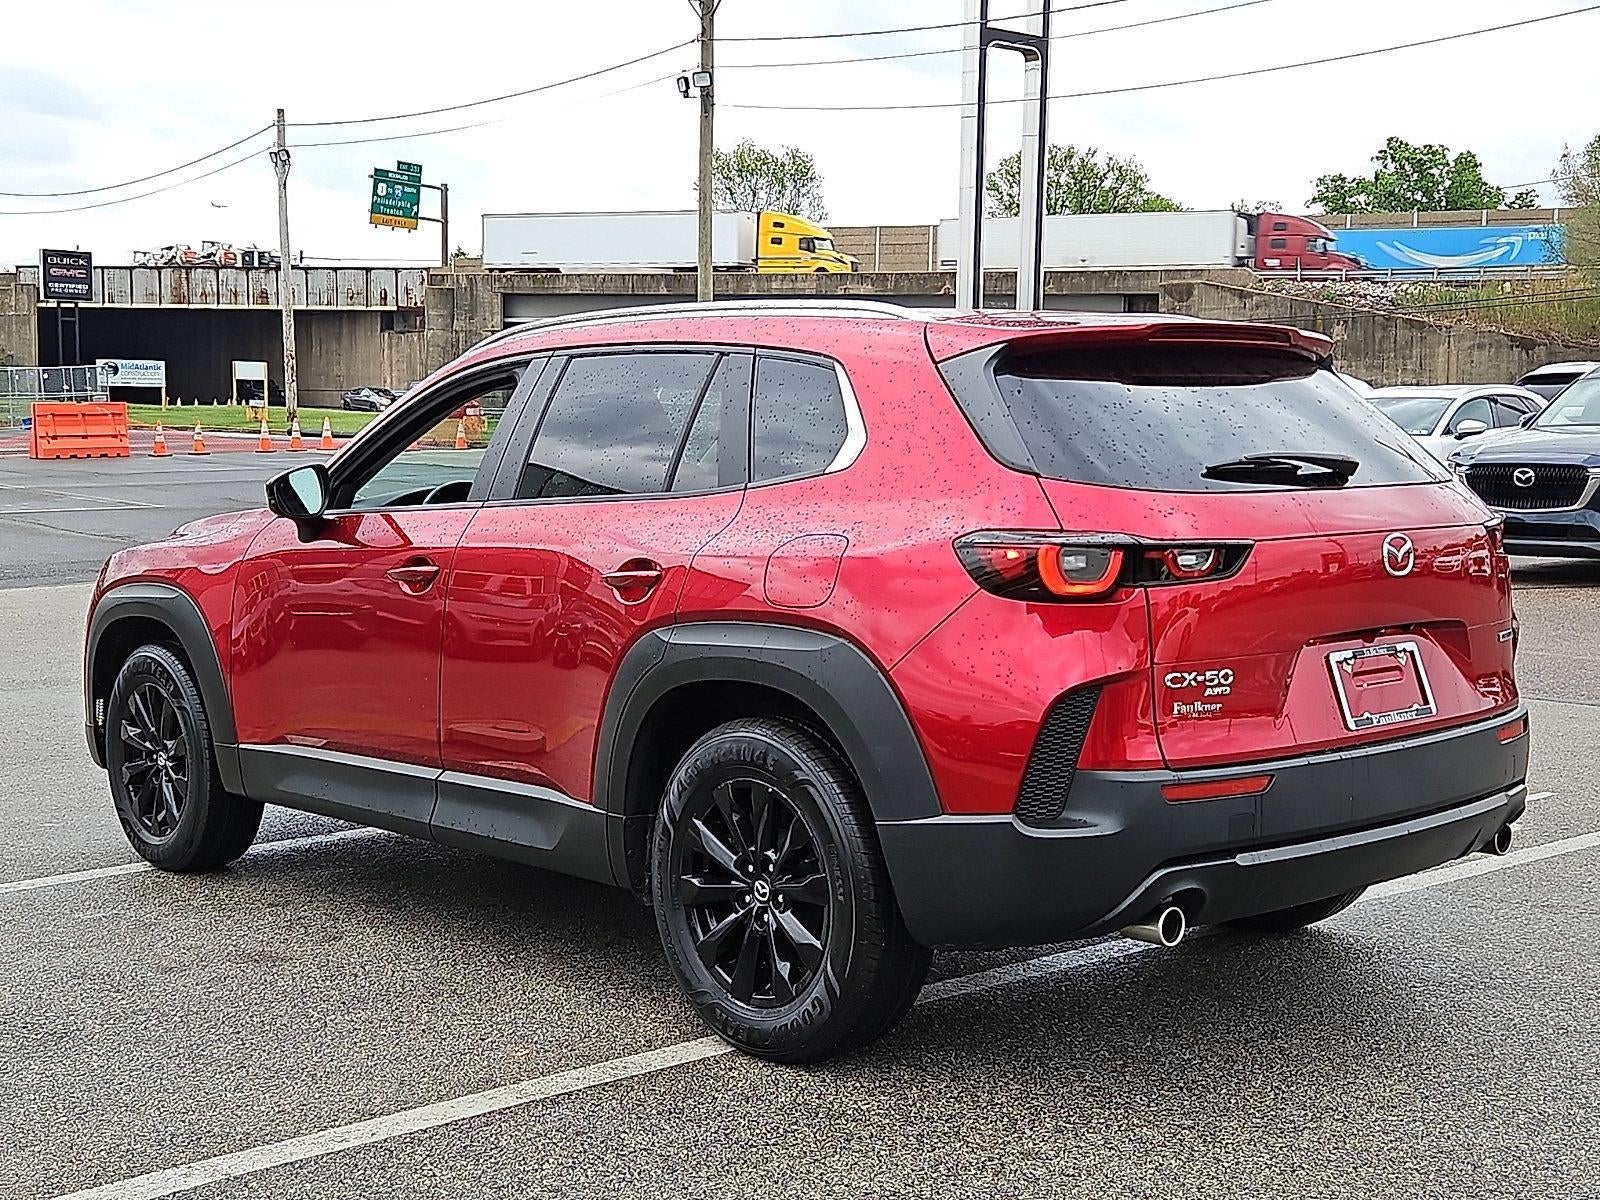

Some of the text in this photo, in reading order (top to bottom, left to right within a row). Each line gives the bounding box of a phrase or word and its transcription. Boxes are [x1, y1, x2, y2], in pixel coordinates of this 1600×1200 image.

[373, 196, 411, 208] Philadelphia
[380, 205, 404, 216] Trenton
[47, 256, 89, 266] BUICK
[49, 267, 88, 278] GMC
[48, 282, 89, 290] CERTIFIED
[120, 363, 163, 371] MidAtlantic
[1164, 668, 1234, 688] CX-50
[1203, 686, 1231, 697] AWD
[1172, 701, 1223, 715] Faulkner
[1372, 711, 1417, 725] Faulkner
